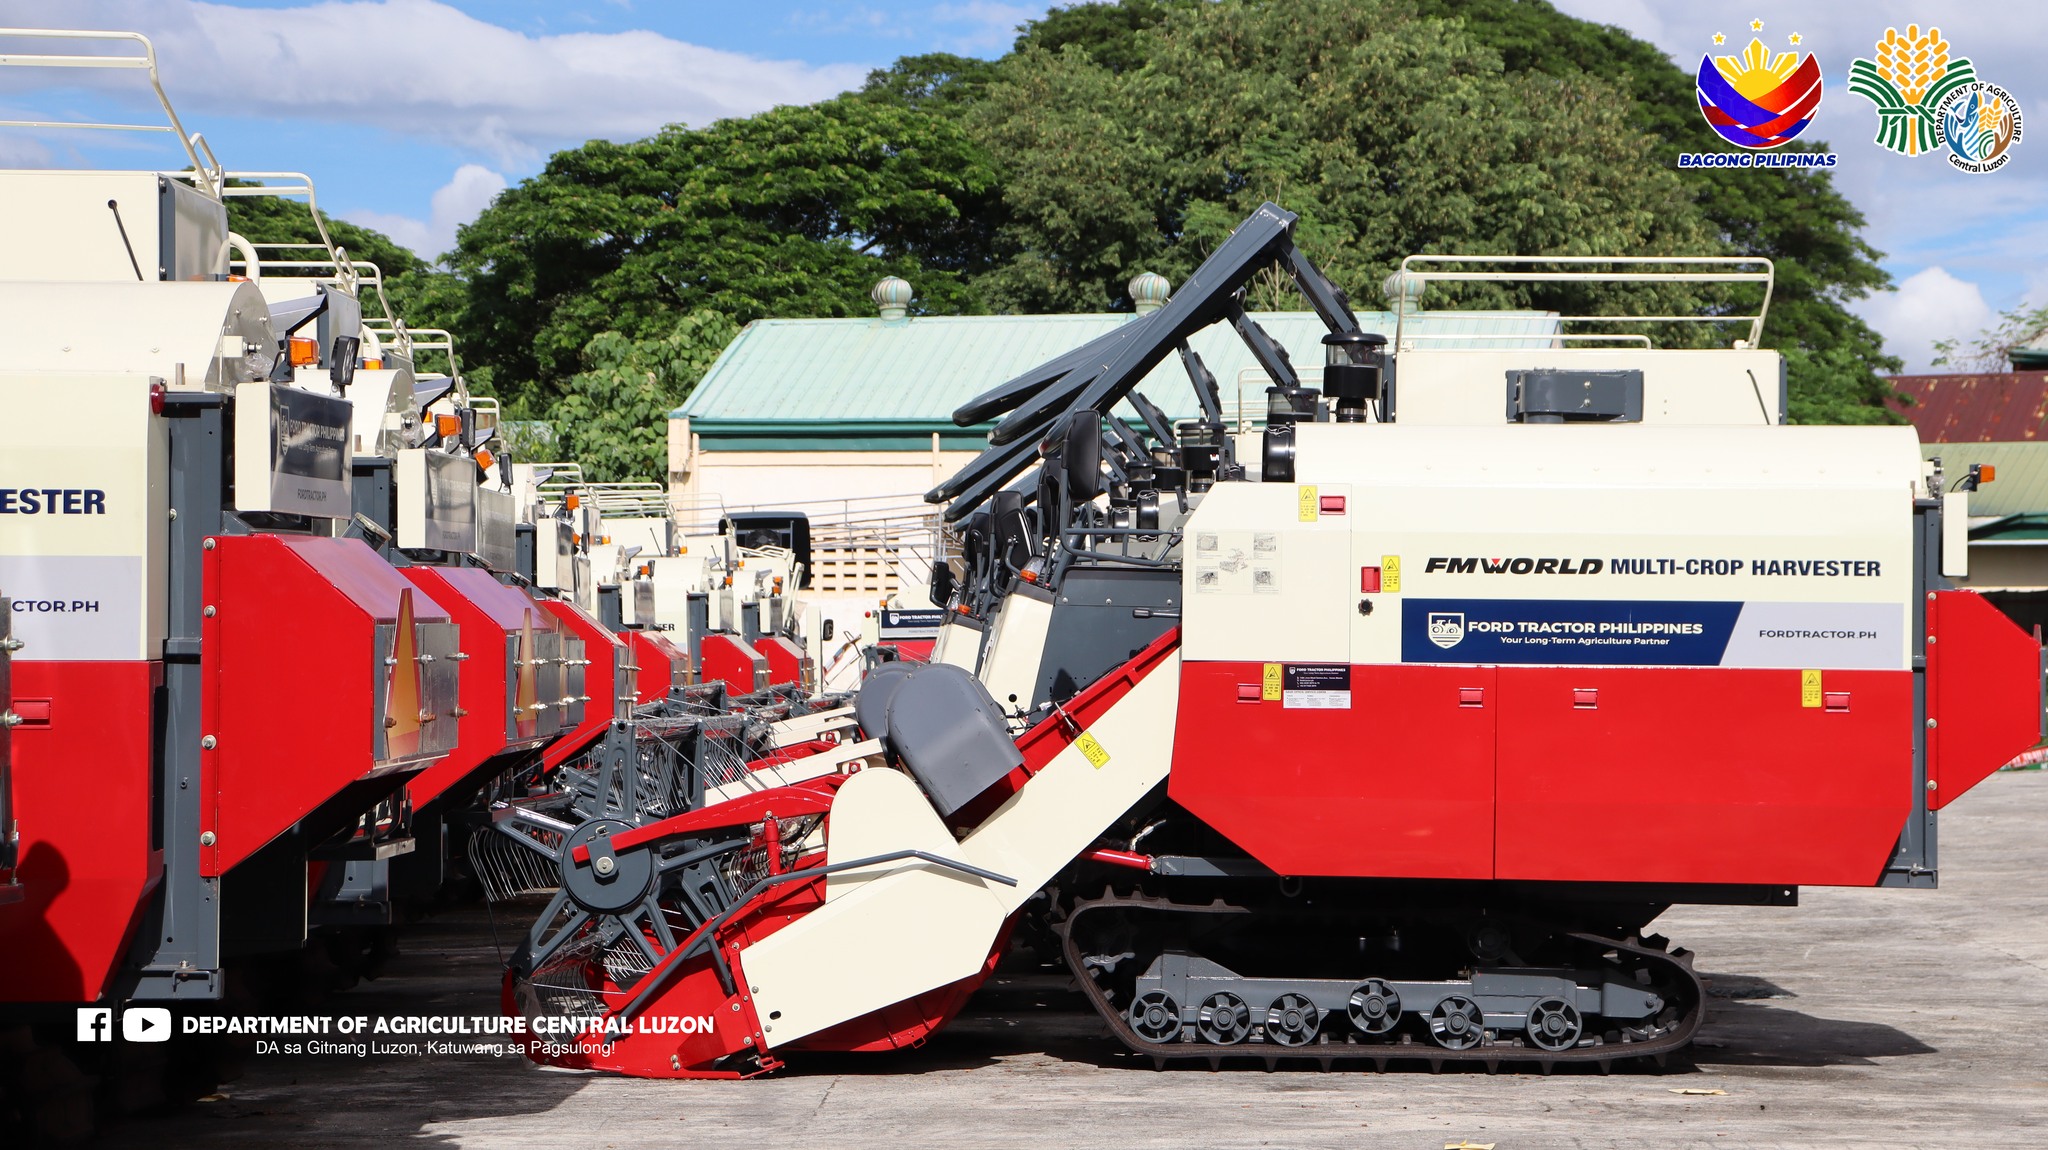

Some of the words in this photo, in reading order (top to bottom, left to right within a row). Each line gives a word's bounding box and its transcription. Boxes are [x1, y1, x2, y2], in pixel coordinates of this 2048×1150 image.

[0, 488, 106, 515] ESTER
[1424, 557, 1604, 575] FMWORLD
[1610, 558, 1744, 576] MULTI-CROP
[1752, 559, 1881, 577] HARVESTER
[11, 600, 99, 613] CTOR.PH
[1468, 621, 1515, 633] FORD
[1517, 621, 1596, 634] TRACTOR
[1599, 622, 1703, 635] PHILIPPINES
[1759, 629, 1877, 639] FORDTRACTOR.PH
[1500, 636, 1523, 645] Your
[1524, 636, 1576, 646] Long-Term
[1577, 637, 1632, 646] Agriculture
[1633, 637, 1670, 646] Partner
